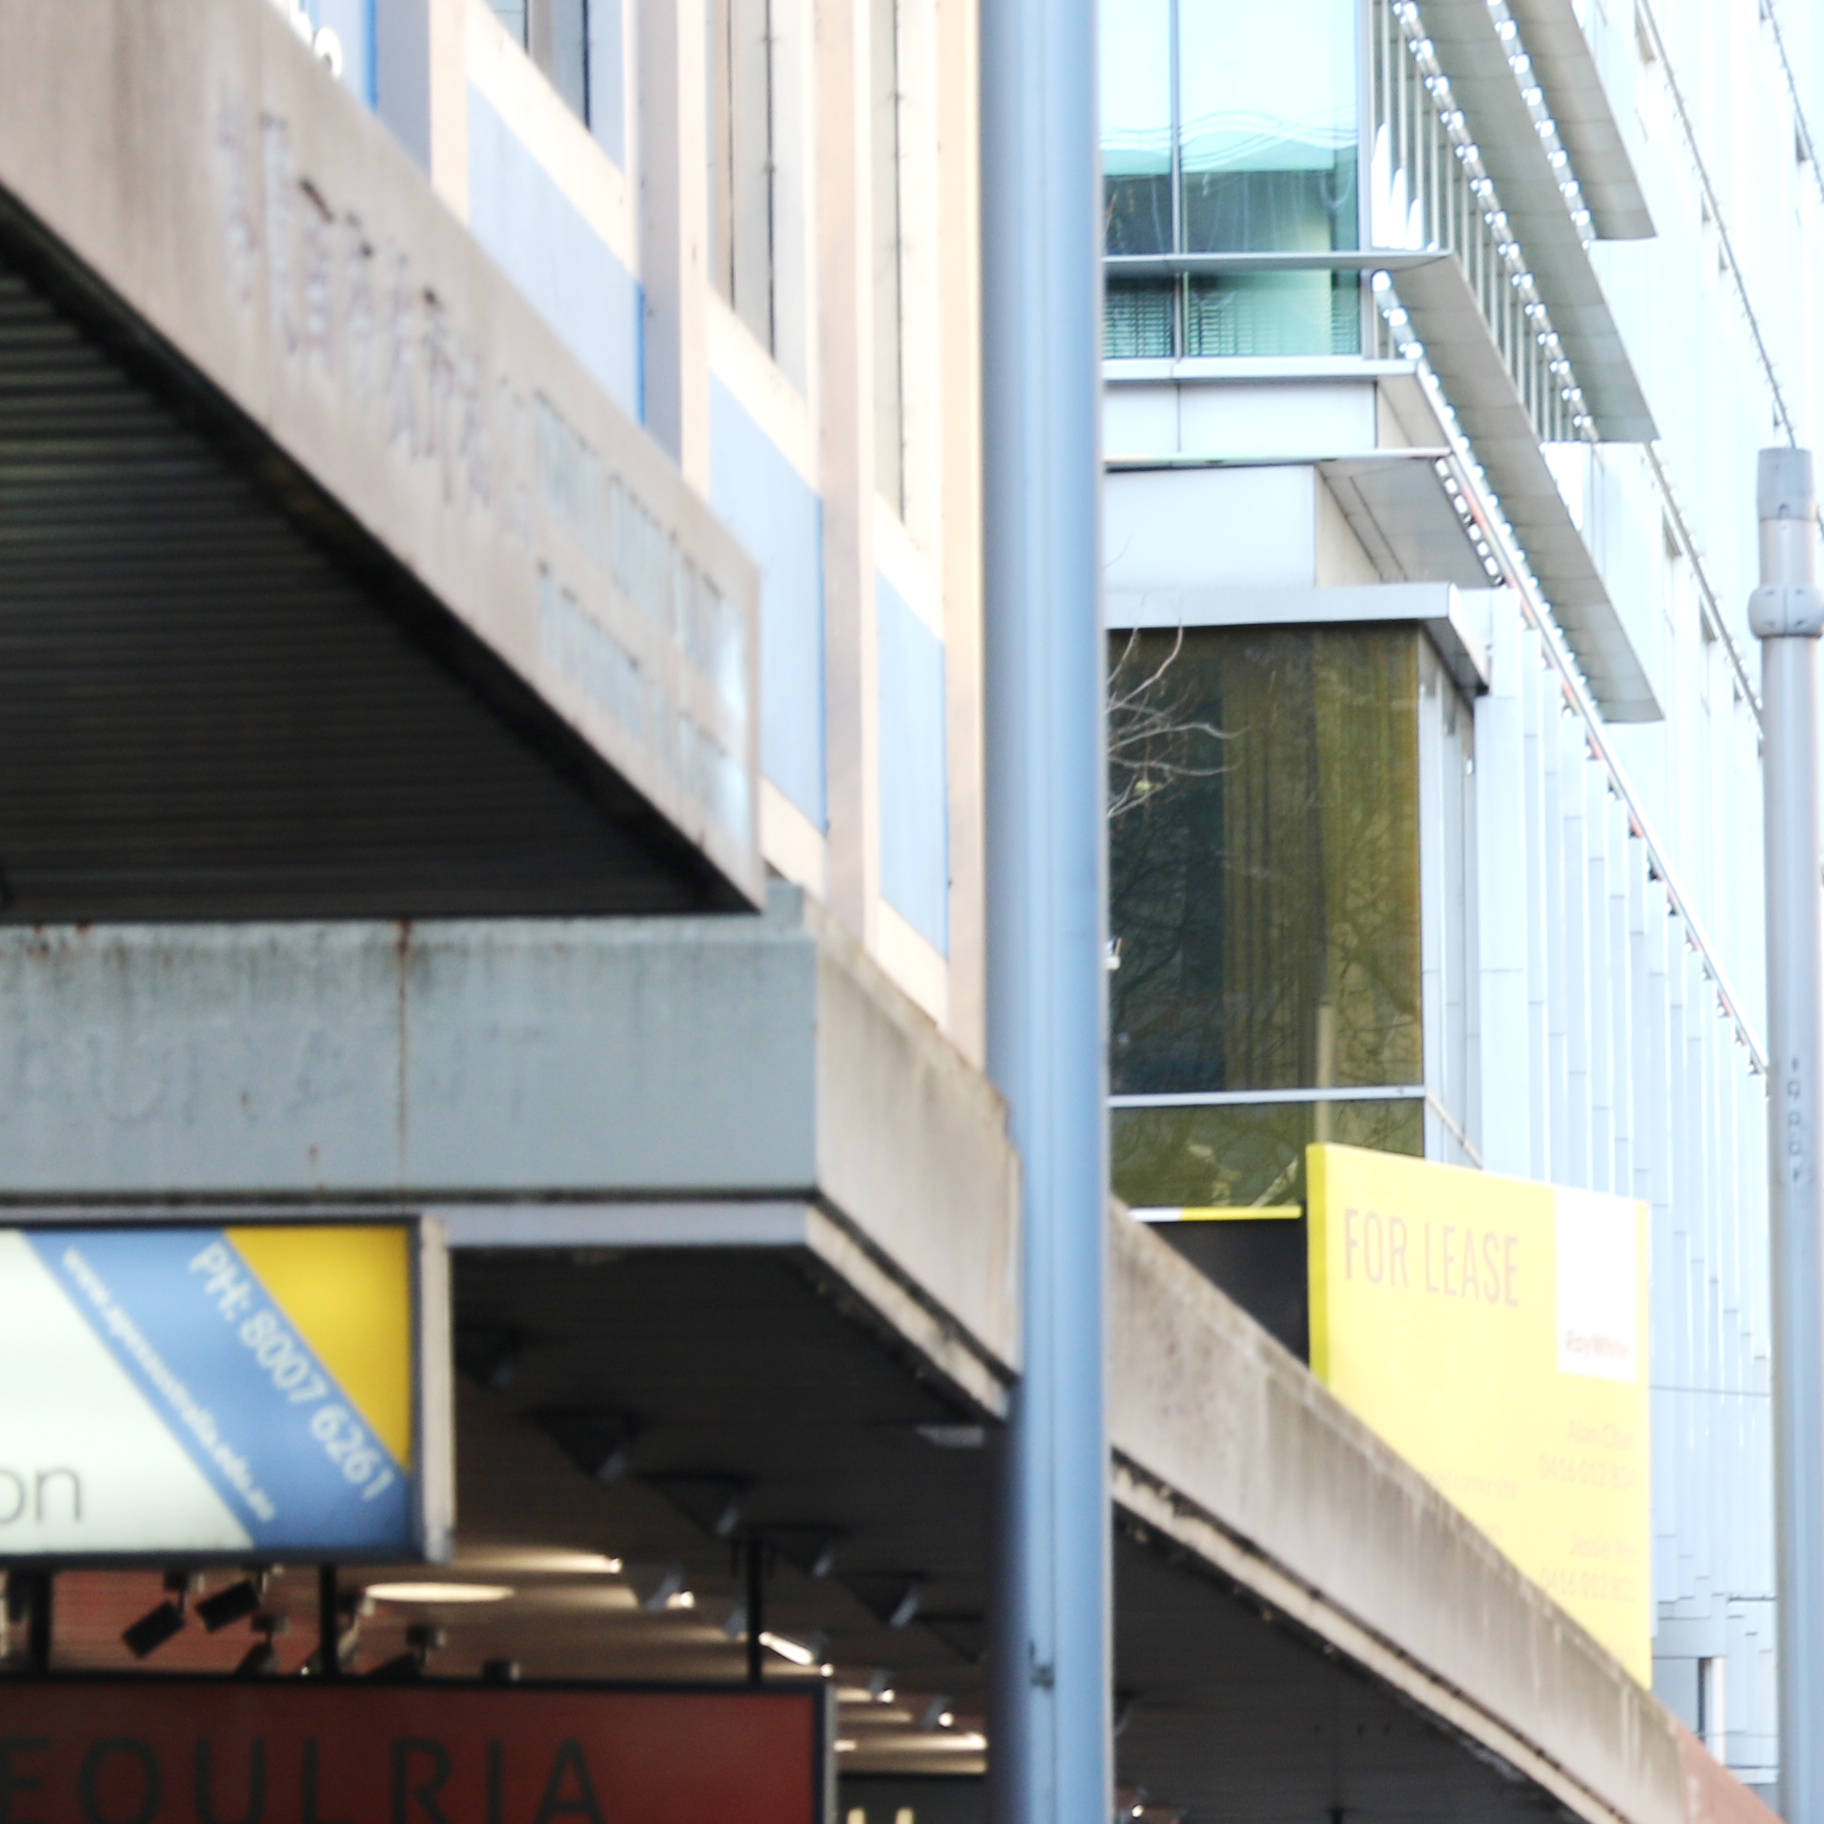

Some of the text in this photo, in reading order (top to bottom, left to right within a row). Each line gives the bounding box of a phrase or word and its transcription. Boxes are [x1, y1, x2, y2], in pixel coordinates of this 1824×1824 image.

[1343, 1207, 1520, 1308] FOR LEASE
[188, 1240, 395, 1501] PH: 8007 6261
